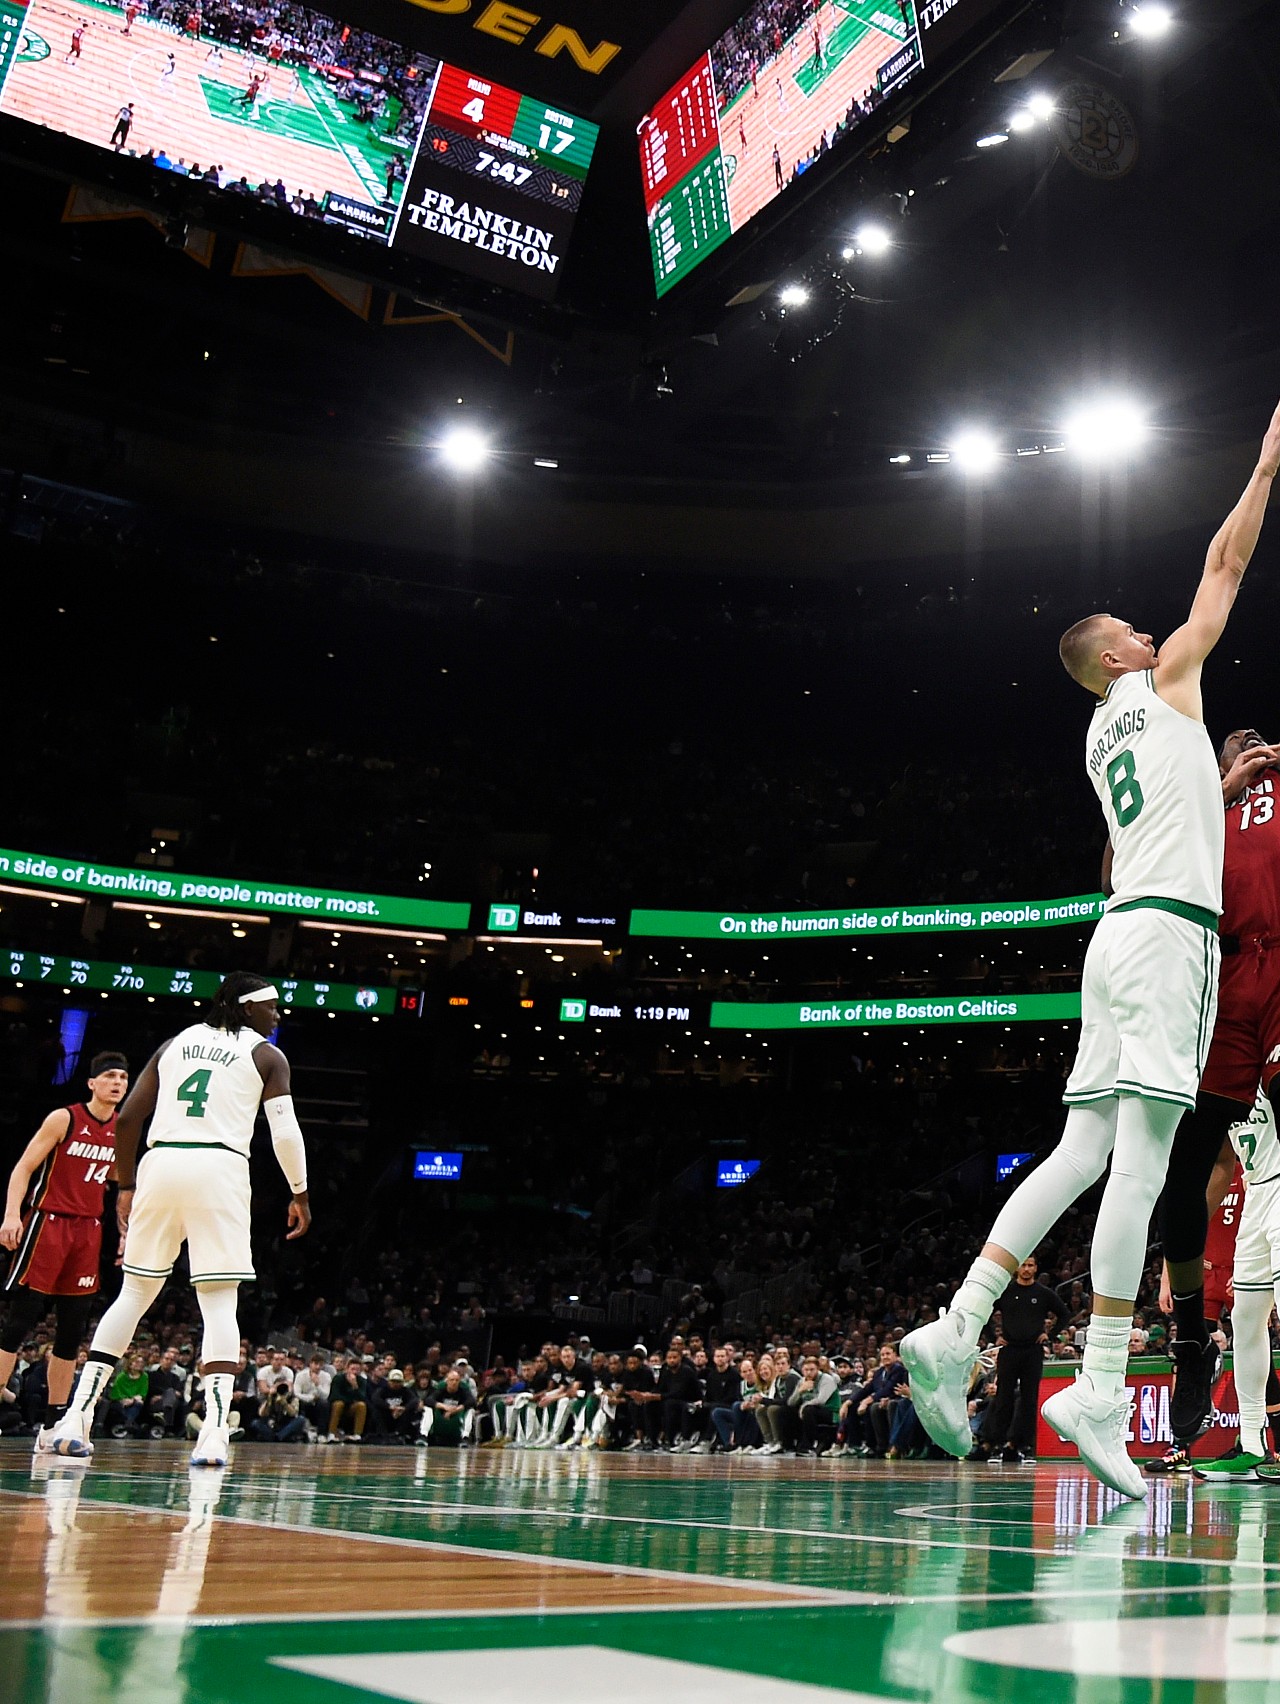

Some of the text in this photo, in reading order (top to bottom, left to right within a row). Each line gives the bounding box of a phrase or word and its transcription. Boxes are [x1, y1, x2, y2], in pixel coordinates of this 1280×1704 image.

[467, 78, 492, 96] MIAMI
[462, 98, 485, 123] 4
[432, 138, 448, 152] 15
[537, 123, 576, 155] 17
[475, 152, 532, 186] 7:47
[550, 183, 569, 198] 1st
[421, 188, 554, 251] FRANKLIN
[407, 204, 559, 273] TEMPLETON
[1089, 708, 1146, 776] PORZINGIS
[1107, 749, 1144, 828] 8
[1240, 796, 1274, 831] 13
[14, 858, 58, 879] side
[62, 867, 85, 883] of
[87, 869, 176, 897] banking,
[181, 883, 251, 902] people
[255, 890, 323, 909] matter
[326, 897, 380, 915] most.
[492, 908, 517, 927] TD
[523, 911, 562, 927] Bank
[720, 917, 747, 933] On
[750, 917, 778, 933] the
[781, 916, 839, 932] human
[842, 913, 877, 930] side
[881, 911, 899, 927] of
[902, 909, 977, 927] banking,
[980, 906, 1040, 926] people
[1044, 900, 1096, 920] matter
[10, 962, 326, 1006] 0 7 70 7/10 3/5 6 6
[401, 996, 417, 1010] 15
[563, 1002, 584, 1018] TD
[589, 1005, 690, 1020] Bank 1:19 PM
[800, 1000, 1017, 1022] Bank of the Boston Celtics
[182, 1045, 240, 1067] HOLIDAY
[177, 1068, 213, 1118] 4
[1238, 1133, 1257, 1171] 7
[83, 1163, 110, 1184] 14
[1223, 1209, 1234, 1225] 5
